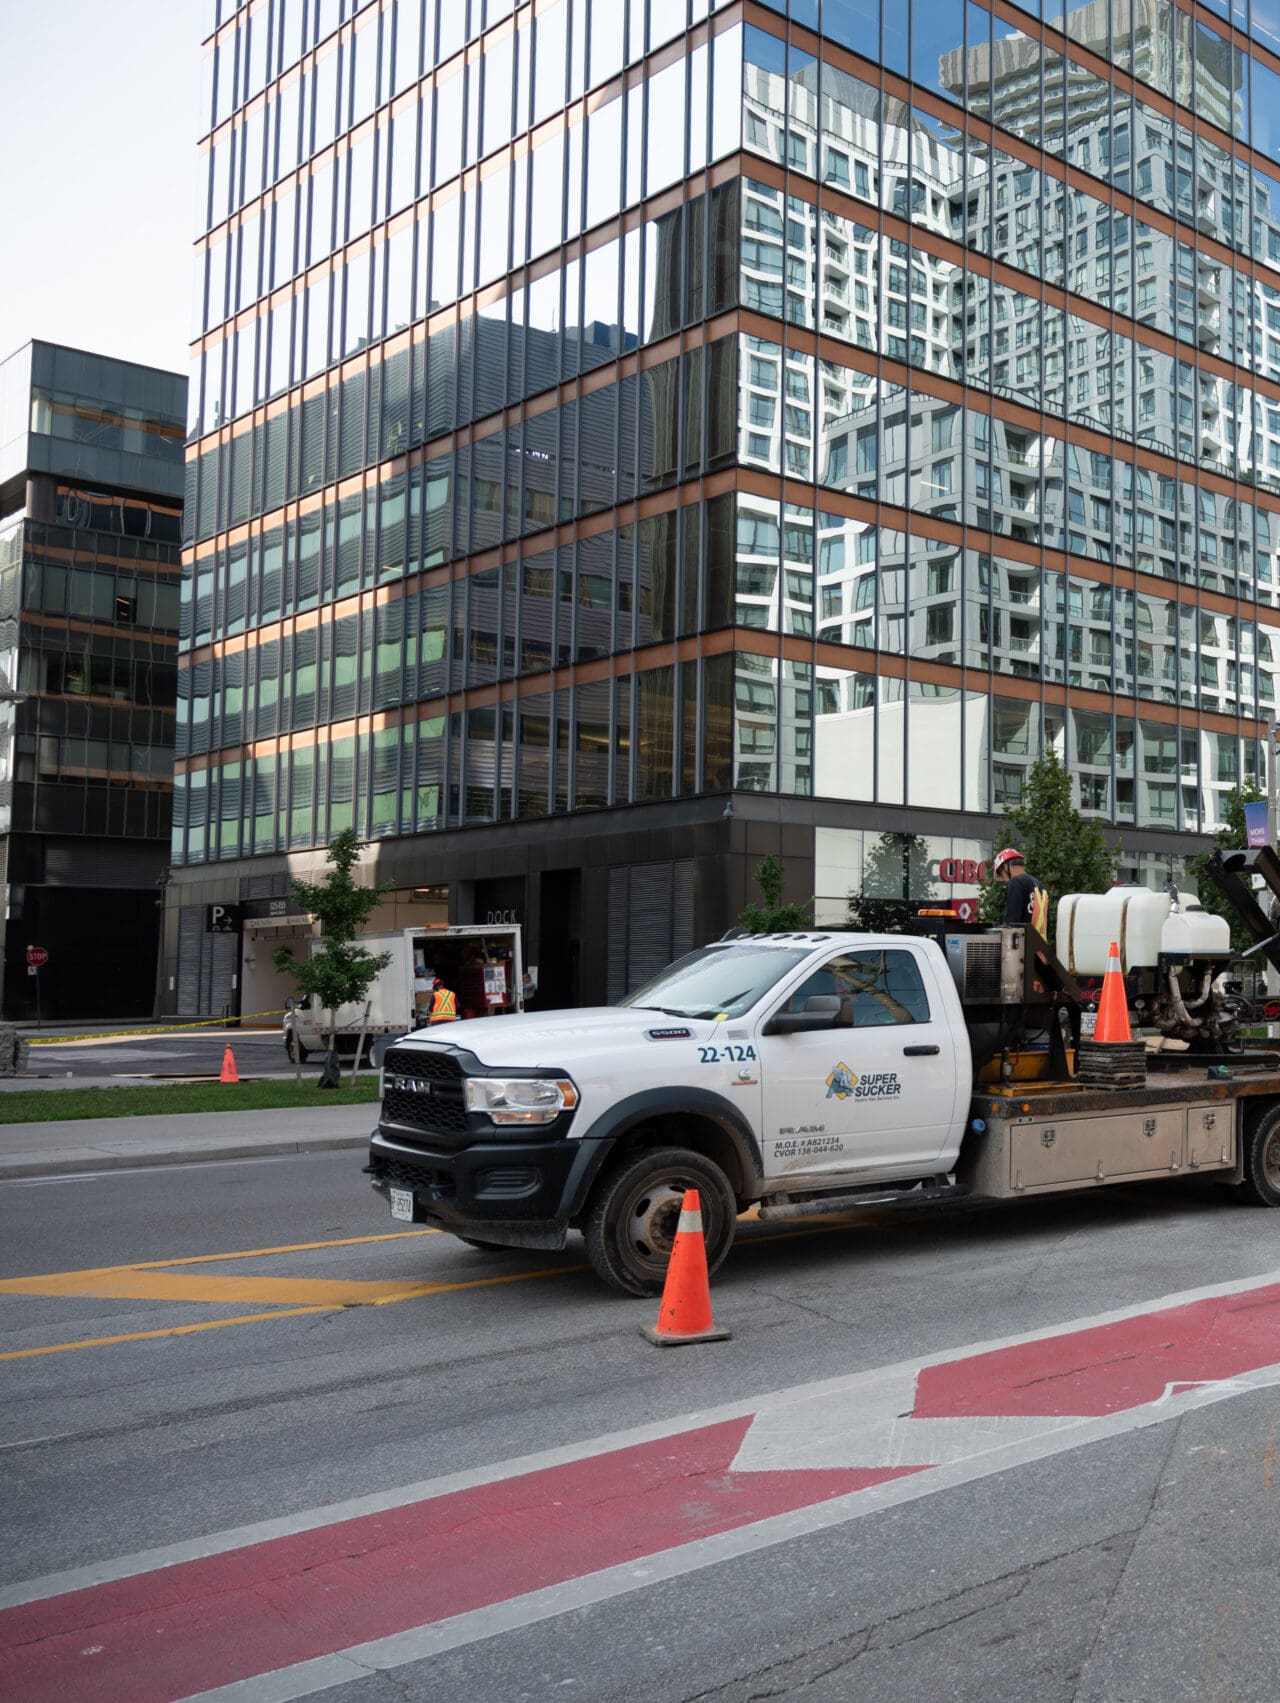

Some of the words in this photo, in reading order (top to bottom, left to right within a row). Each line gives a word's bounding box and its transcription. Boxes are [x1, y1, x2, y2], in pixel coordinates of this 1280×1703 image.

[1250, 828, 1265, 836] MORE
[939, 858, 992, 884] CIBC
[212, 906, 225, 924] P
[487, 909, 516, 925] DOCK
[30, 952, 48, 961] STOP
[698, 1045, 756, 1064] 22-124
[395, 1077, 431, 1093] RAM
[860, 1073, 898, 1086] SUPER
[854, 1083, 902, 1097] SUCKER
[775, 1140, 800, 1149] M.O.E.
[806, 1137, 840, 1147] A821234
[774, 1149, 796, 1158] CVOR
[797, 1144, 844, 1156] 138-044-620
